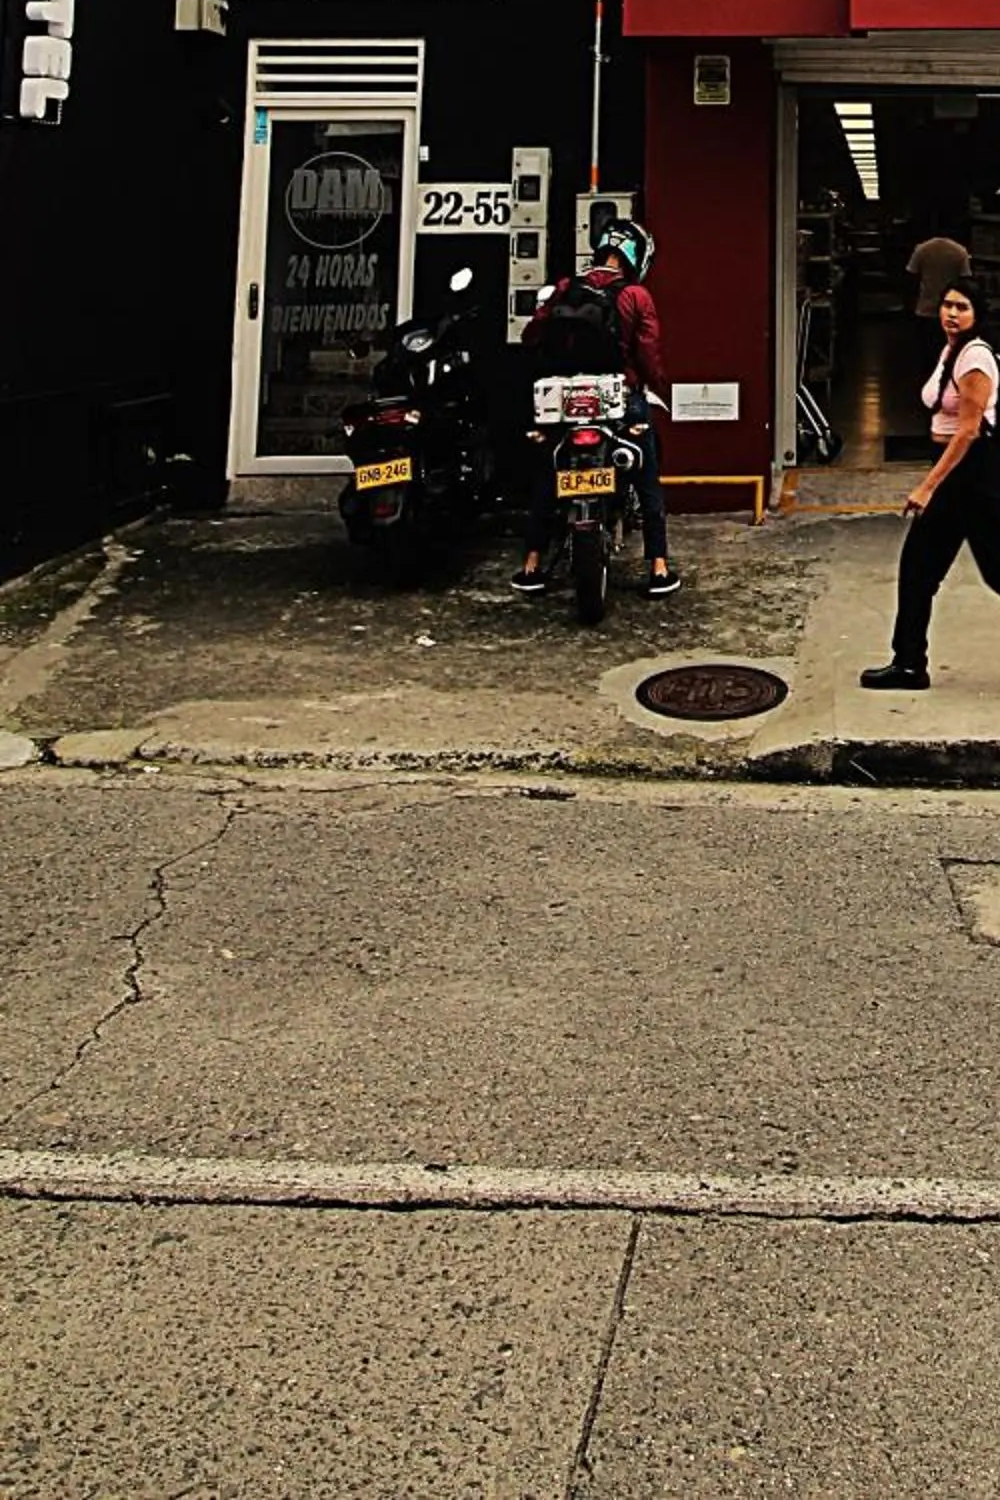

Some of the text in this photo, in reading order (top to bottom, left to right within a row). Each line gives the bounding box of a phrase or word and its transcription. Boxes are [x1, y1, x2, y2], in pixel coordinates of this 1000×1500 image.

[291, 168, 381, 209] DAM
[423, 191, 511, 226] 22-55
[286, 253, 379, 288] 24 HORAS
[270, 303, 390, 333] BIENVENIDOS
